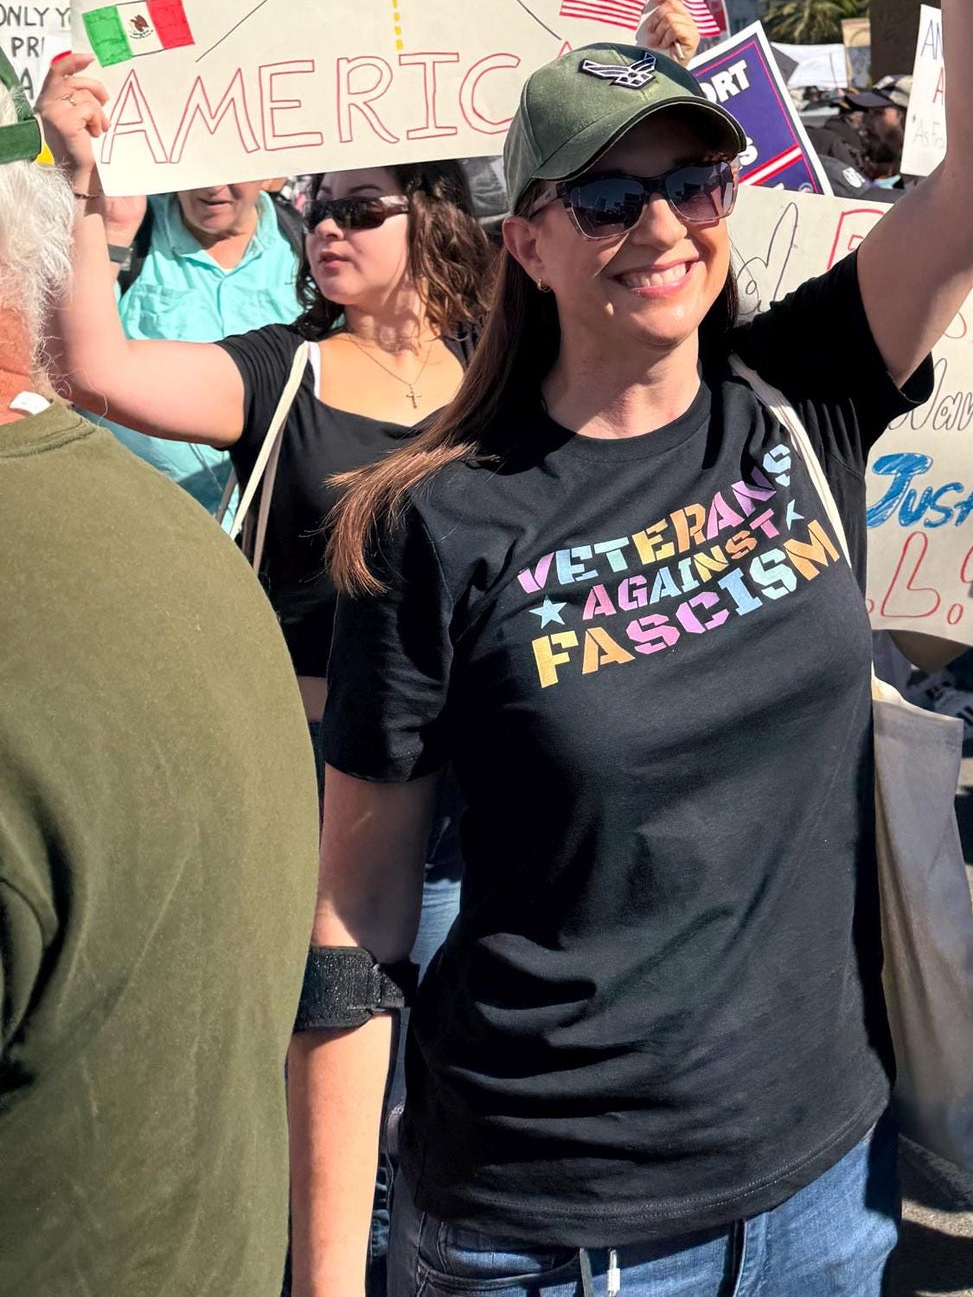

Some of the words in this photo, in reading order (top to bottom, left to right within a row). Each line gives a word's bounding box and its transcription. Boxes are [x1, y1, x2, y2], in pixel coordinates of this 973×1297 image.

[101, 40, 572, 164] AMERIC
[516, 443, 792, 594] VETERANS
[582, 508, 782, 621] AGAINST
[531, 519, 841, 689] FASCISM
